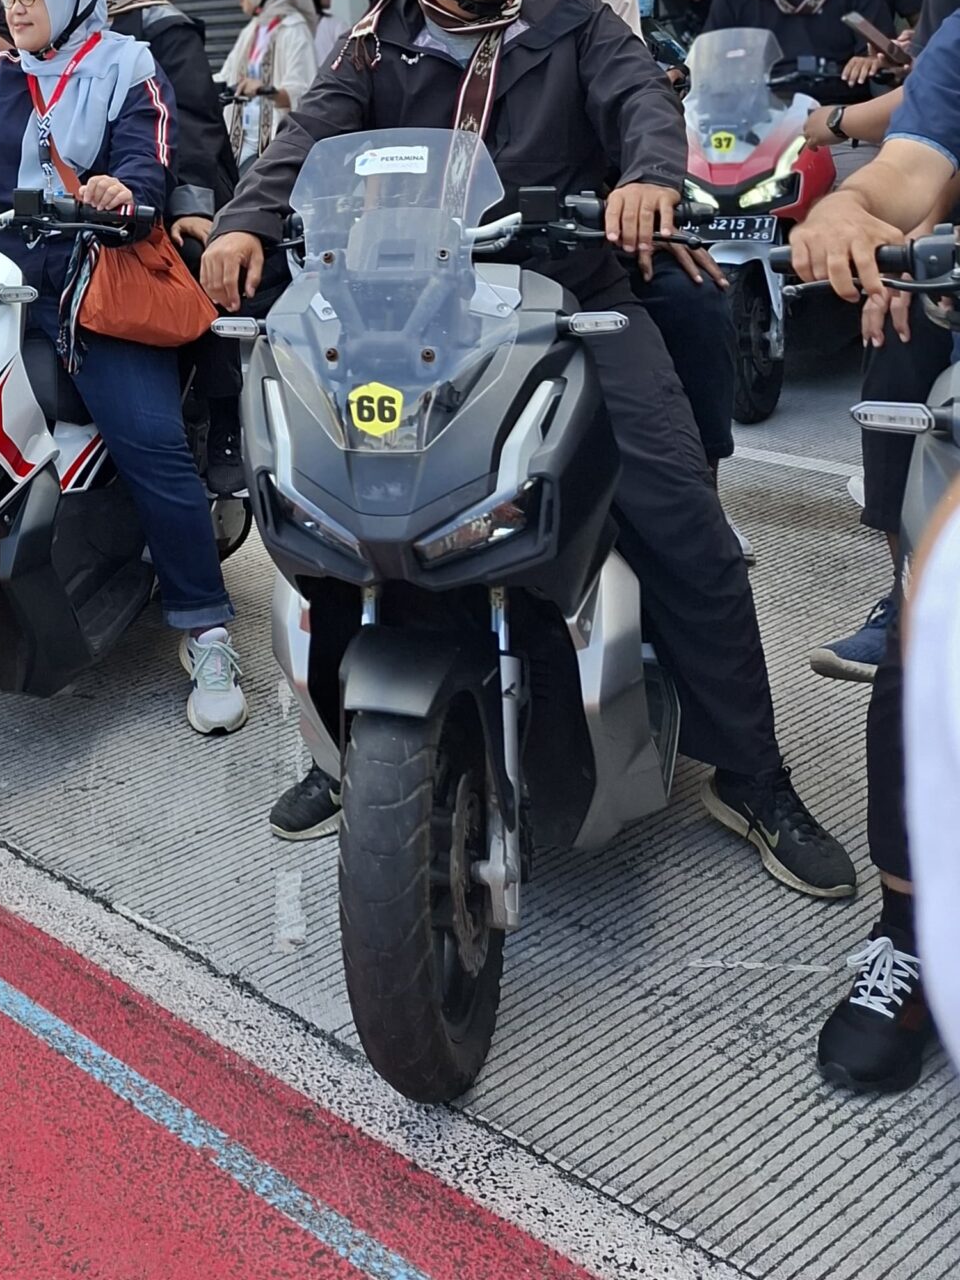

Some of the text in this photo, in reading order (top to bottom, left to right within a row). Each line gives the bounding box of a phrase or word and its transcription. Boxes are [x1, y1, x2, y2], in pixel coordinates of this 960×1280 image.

[713, 136, 733, 149] 37
[380, 154, 425, 162] PERTAMINA
[754, 217, 773, 229] TT
[356, 395, 397, 423] 66
